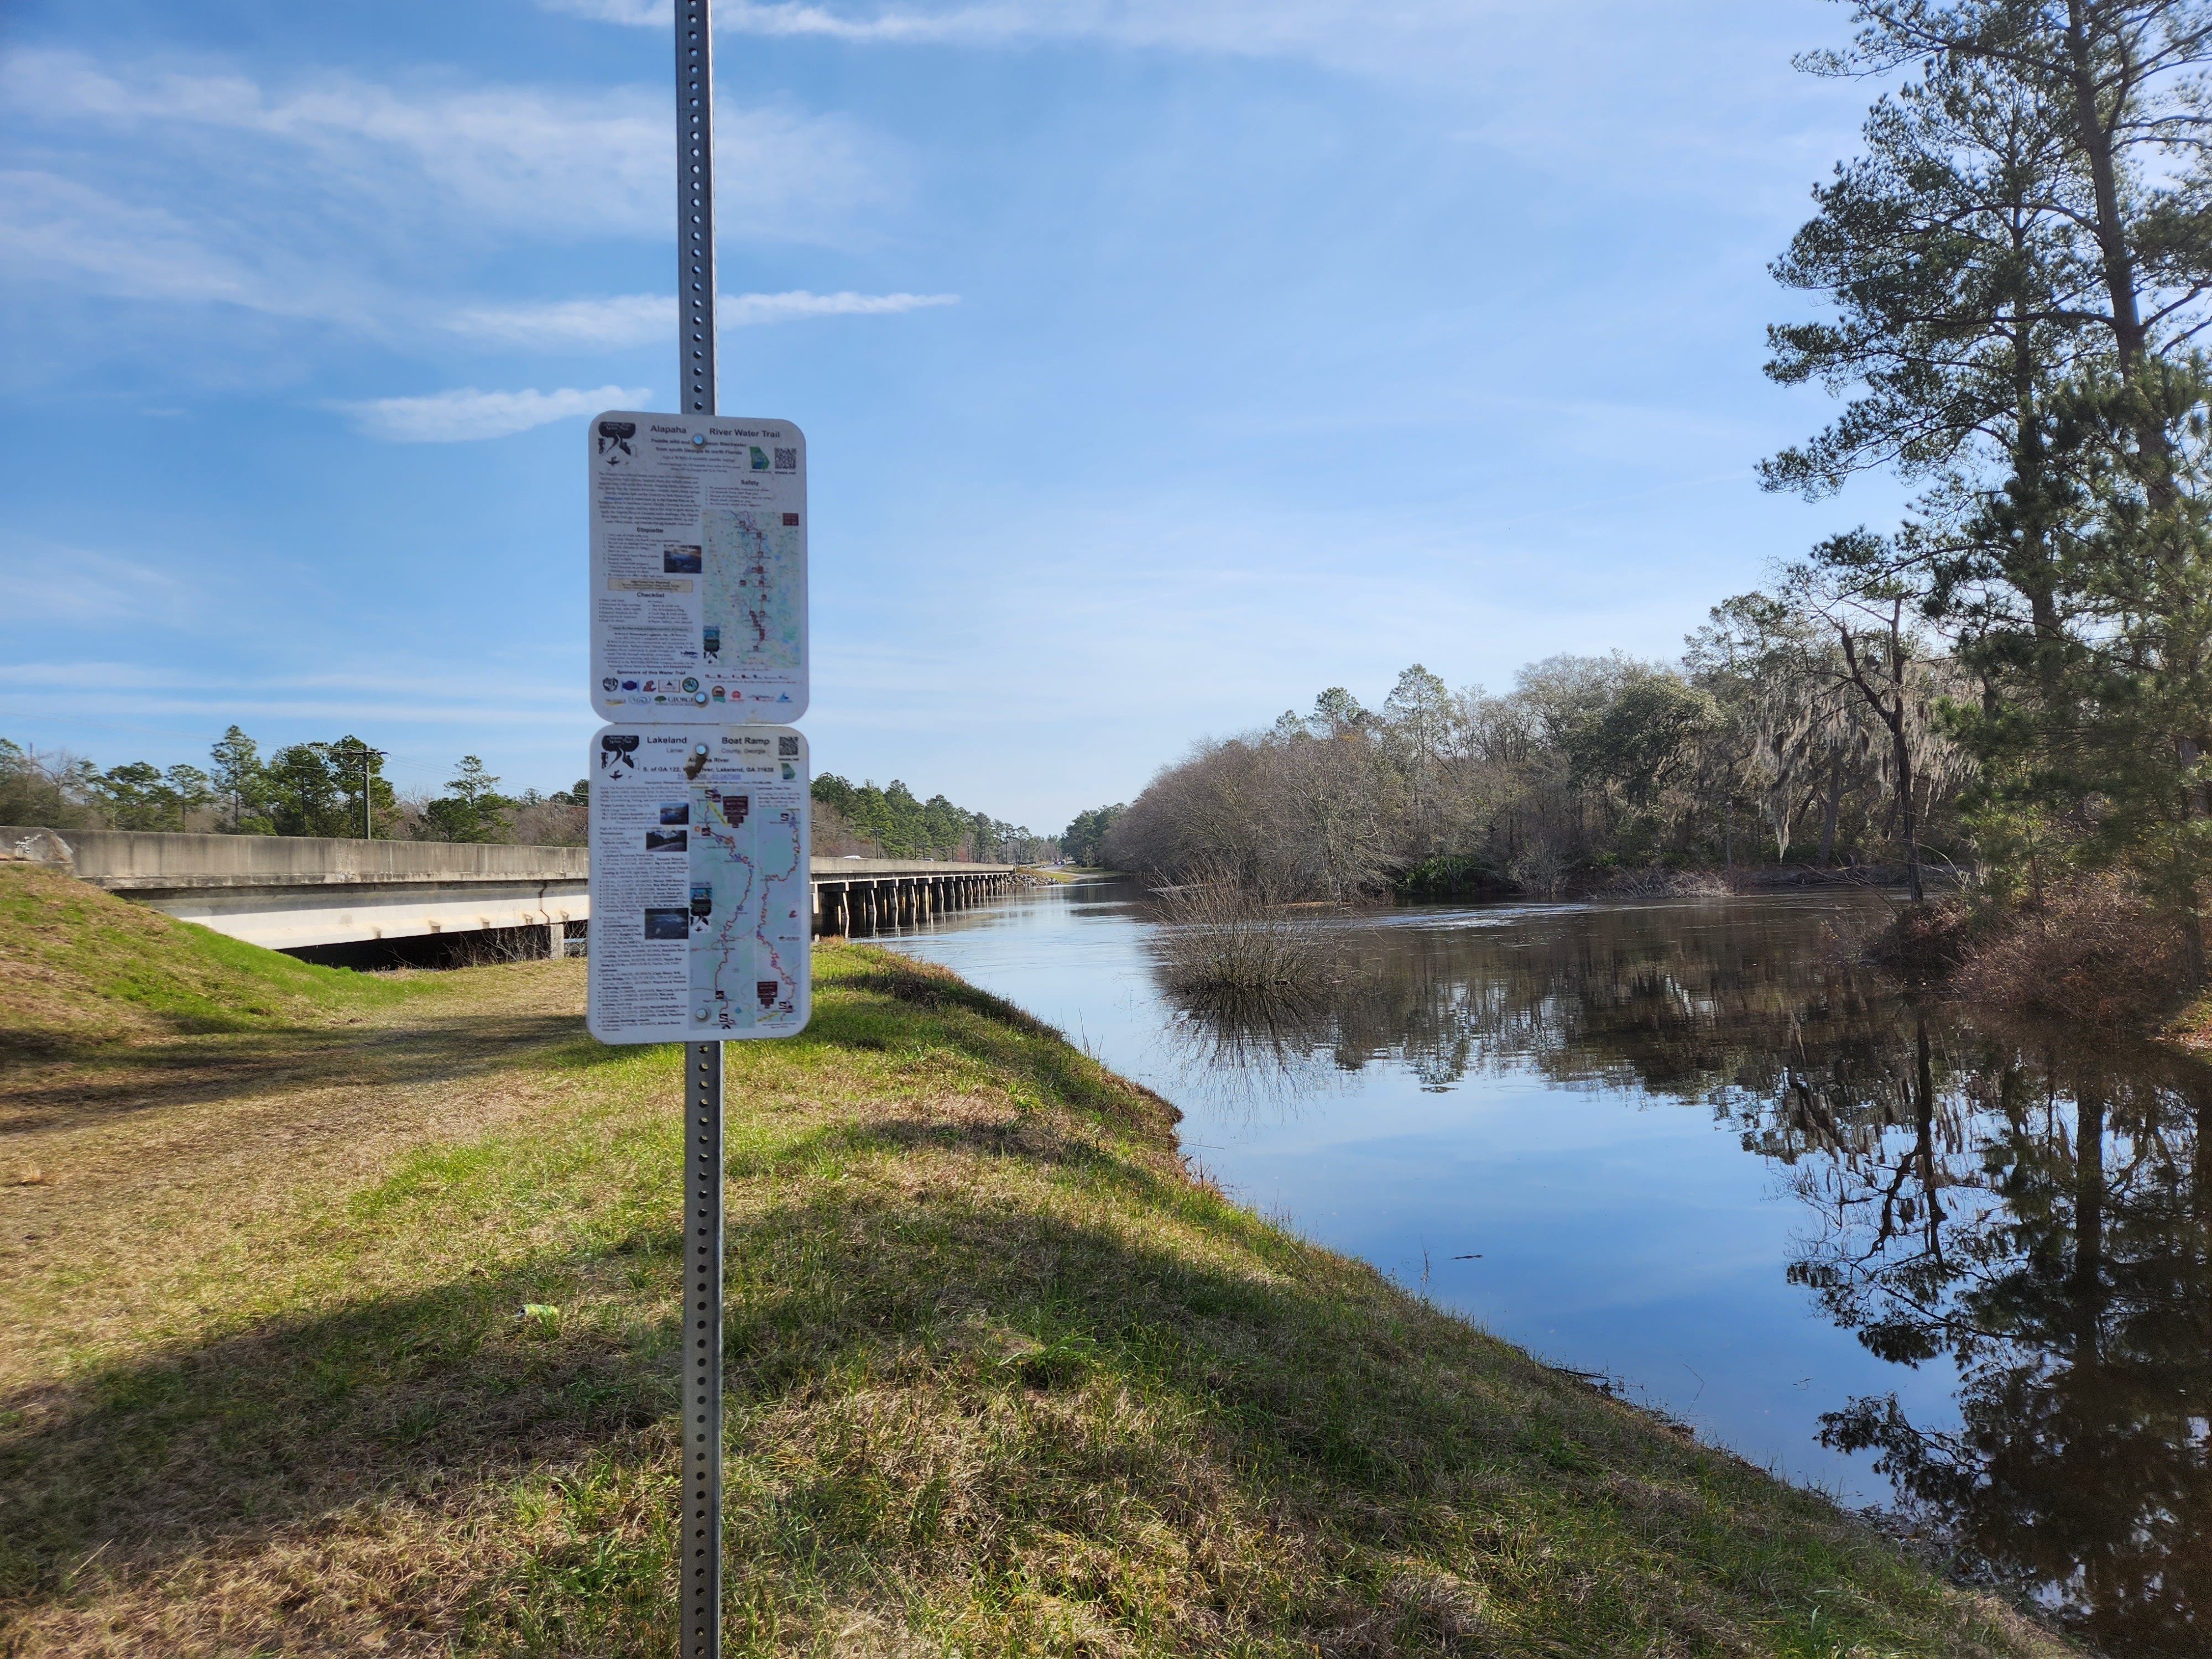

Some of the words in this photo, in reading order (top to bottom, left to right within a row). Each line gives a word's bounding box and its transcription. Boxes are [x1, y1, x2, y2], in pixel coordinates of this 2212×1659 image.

[650, 425, 687, 434] Alapaha
[734, 429, 759, 437] Water
[744, 737, 770, 746] Ramp
